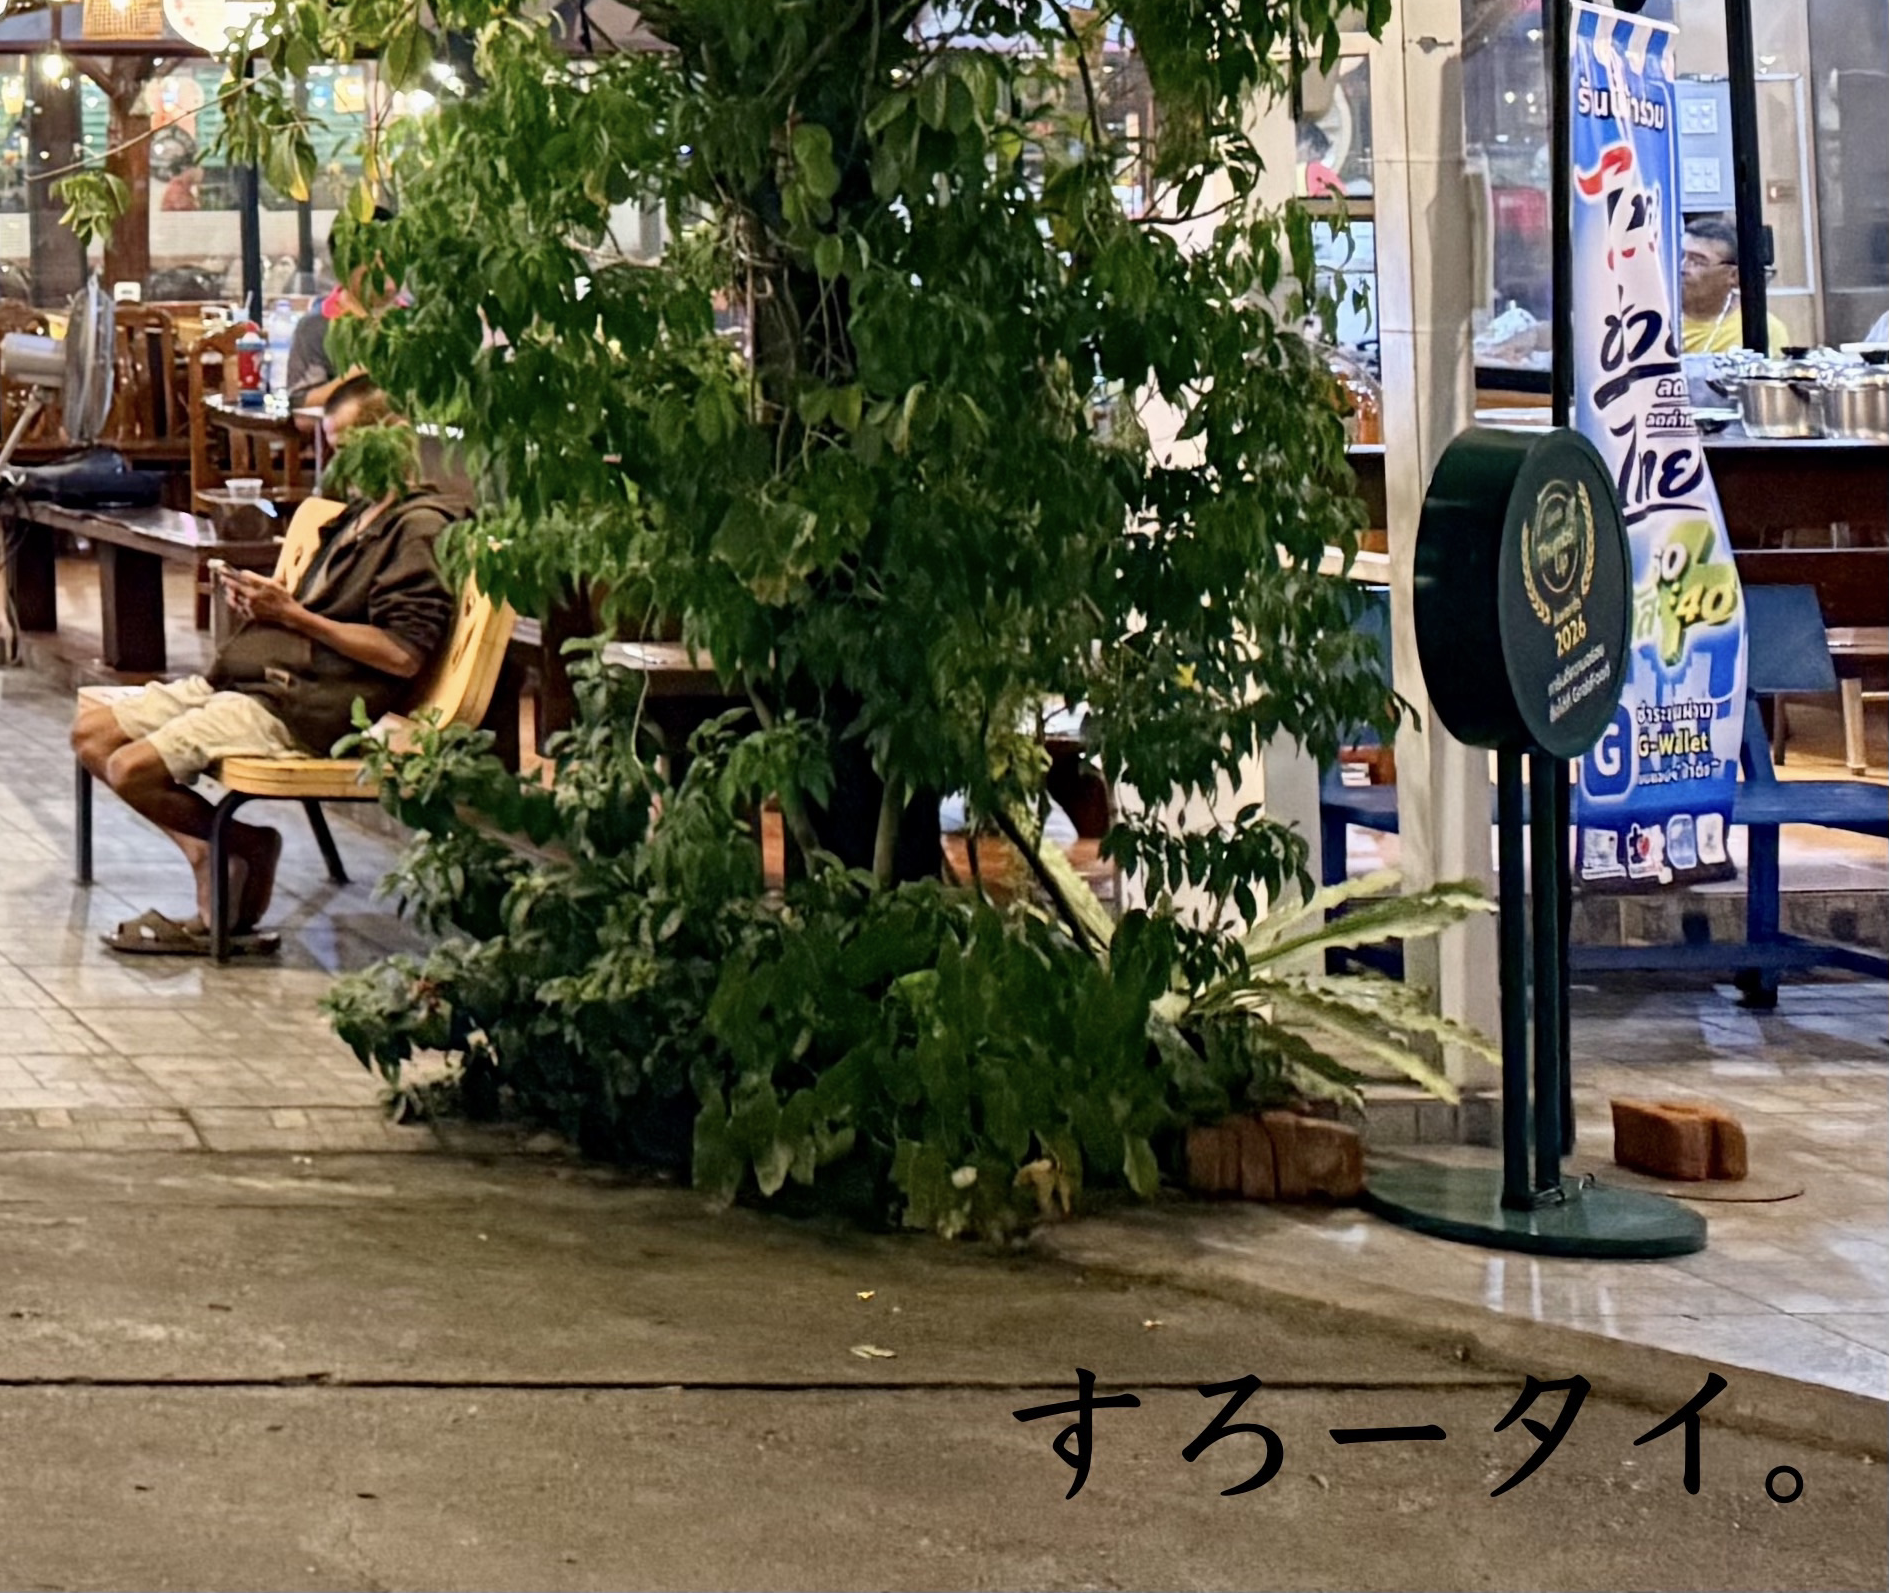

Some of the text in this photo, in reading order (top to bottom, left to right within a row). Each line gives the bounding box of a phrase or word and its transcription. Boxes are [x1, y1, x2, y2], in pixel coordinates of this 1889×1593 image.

[1609, 415, 1705, 508] ไทย
[1555, 614, 1587, 657] 2026
[1637, 728, 1709, 759] G-Wallet
